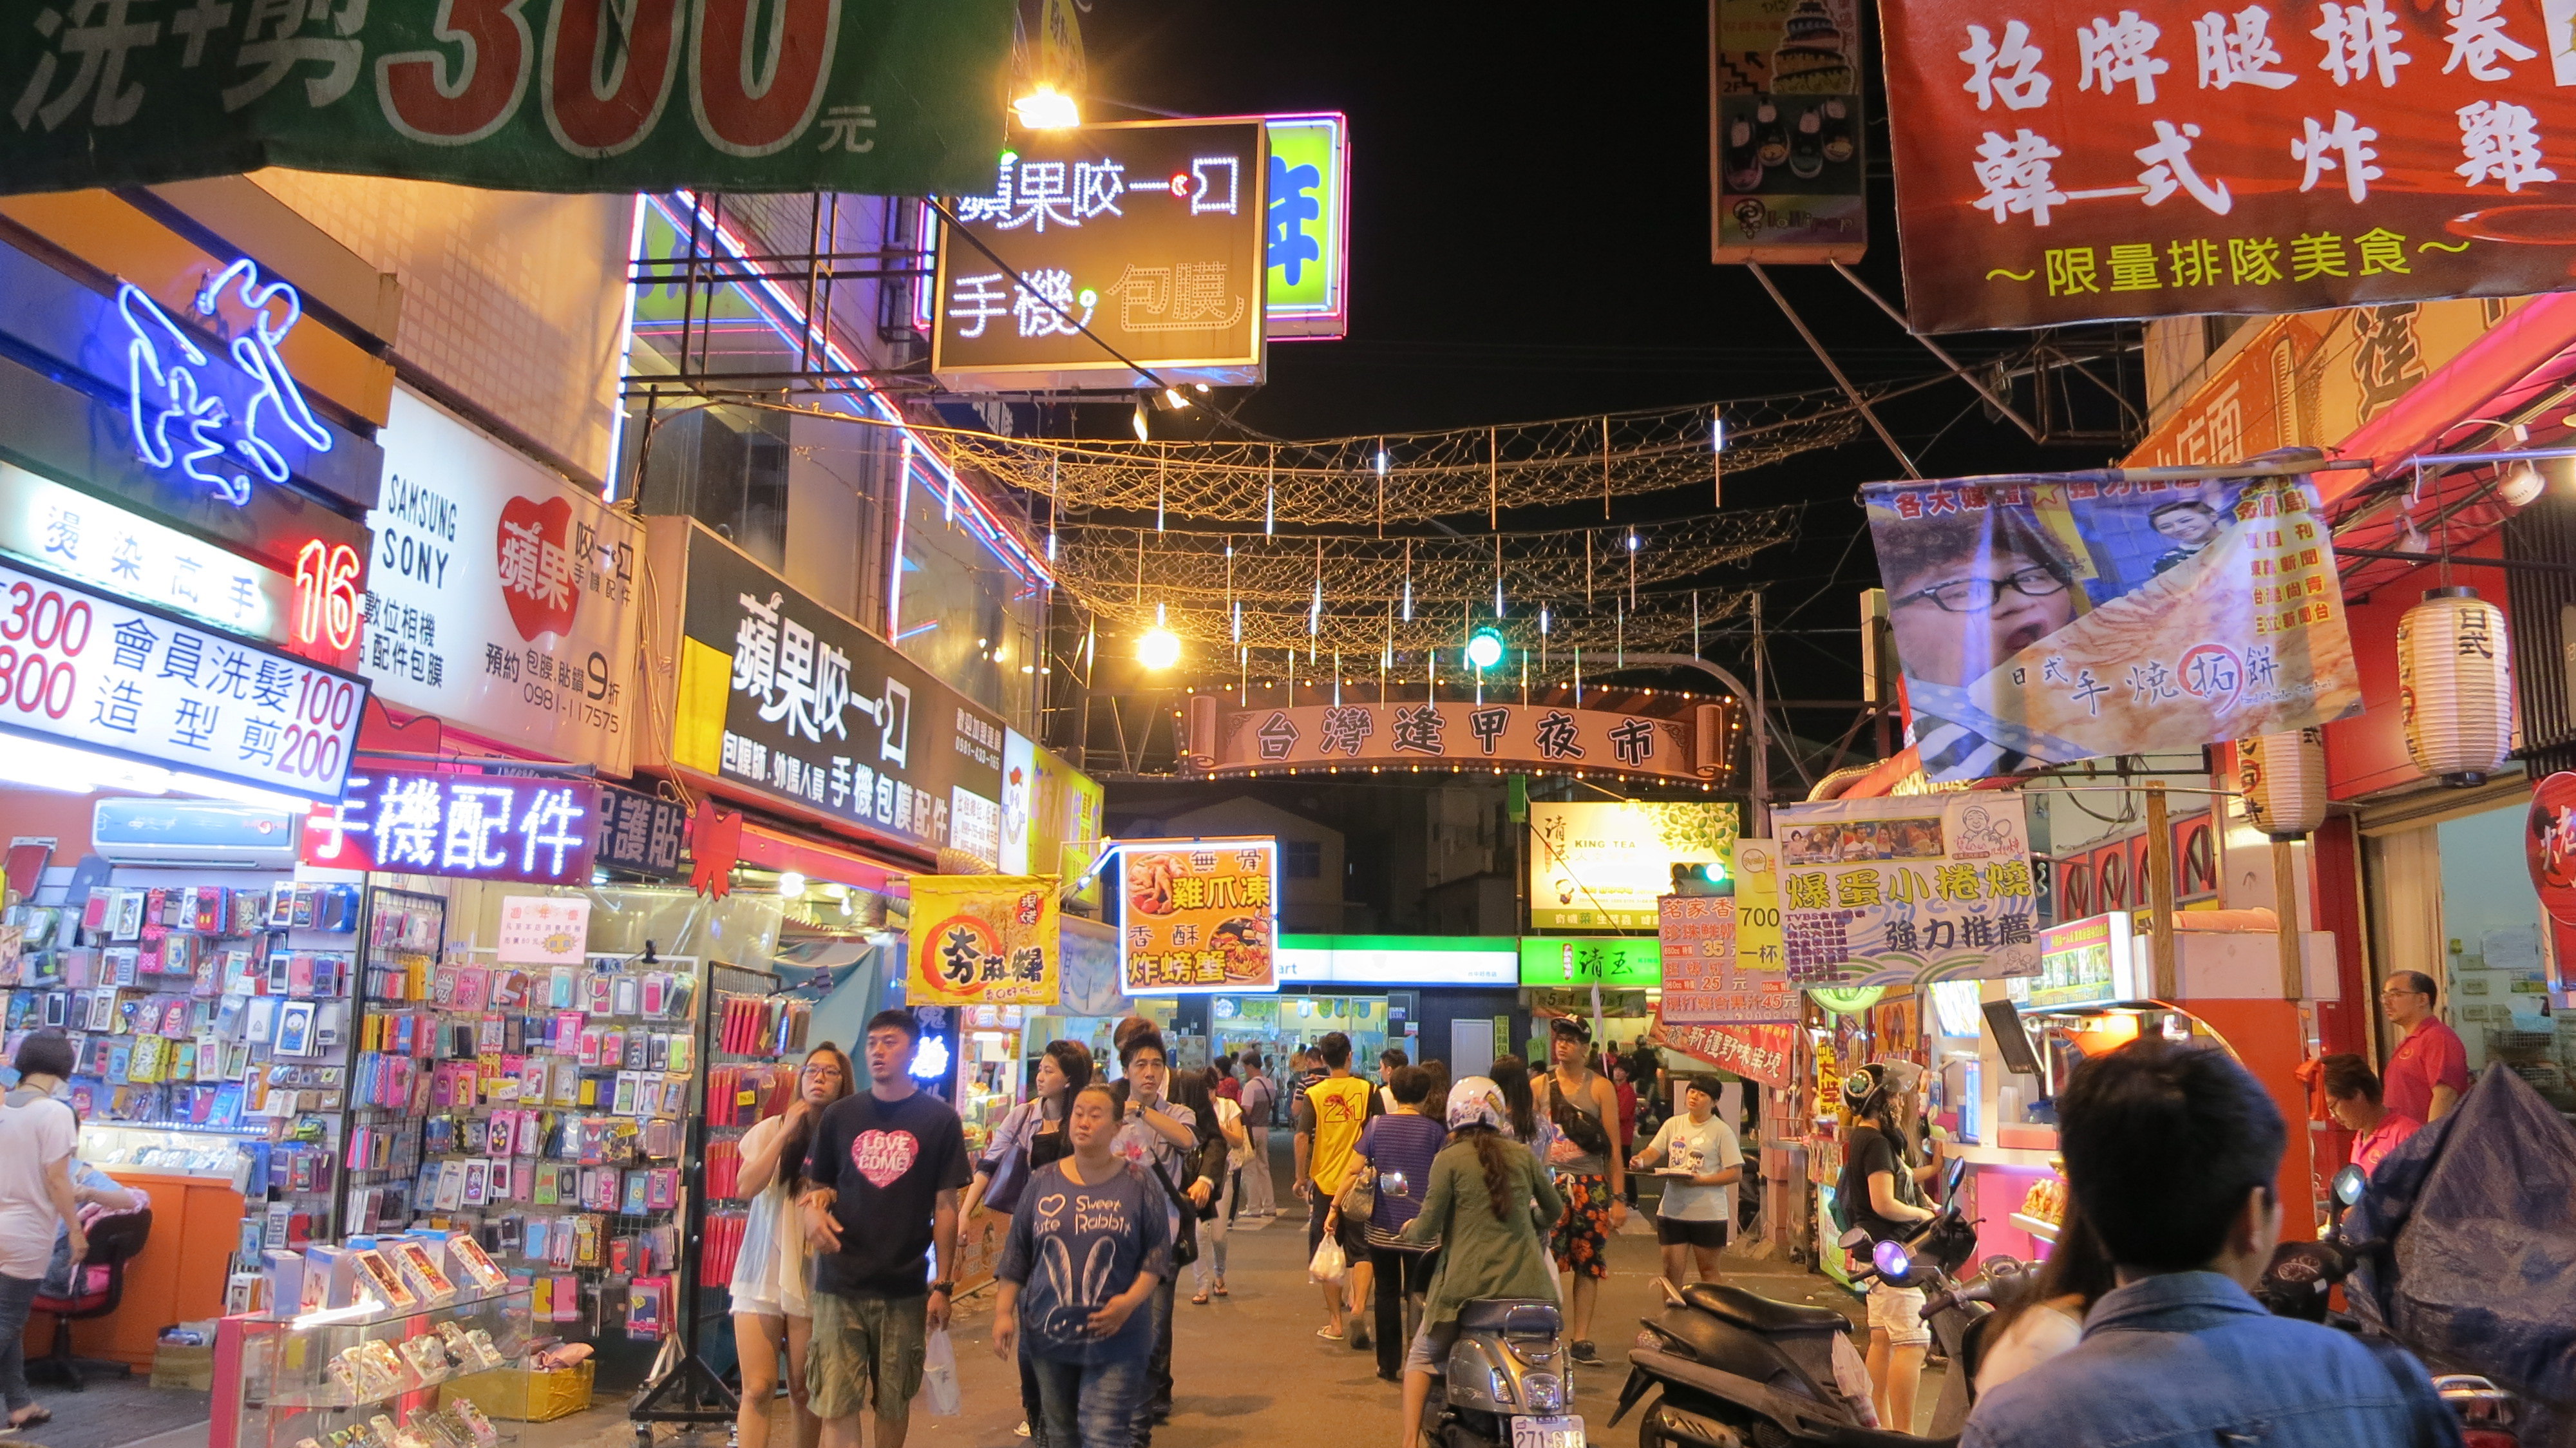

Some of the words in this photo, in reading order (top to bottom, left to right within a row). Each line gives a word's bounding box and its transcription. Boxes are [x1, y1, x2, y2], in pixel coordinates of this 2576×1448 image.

[1958, 0, 2537, 111] 招牌腿排卷
[818, 106, 877, 153] 元
[1972, 100, 2557, 227] 韓式炸雞
[388, 473, 457, 543] SAMSUNG
[45, 504, 255, 618] 燙染高手
[383, 528, 450, 589] SONY
[296, 537, 360, 651] 16
[365, 589, 437, 648] 數位相機
[2458, 607, 2494, 660] 日式
[112, 616, 295, 712] 會員洗髮
[298, 669, 355, 732] 100
[2012, 656, 2069, 686] 日式
[90, 674, 281, 768] 造型剪
[277, 724, 341, 783] 200
[523, 683, 620, 734] 0981-117575
[1256, 703, 1656, 767] 台灣逢甲夜市
[830, 755, 949, 843] 手機包膜配件
[308, 777, 585, 877] 手機配件
[1575, 840, 1605, 849] KING
[1613, 840, 1636, 849] TEA
[1190, 849, 1262, 872] 無骨
[1171, 874, 1273, 910] 雞爪凍
[1739, 908, 1780, 927] 700
[1127, 924, 1200, 947] 香酥
[1702, 940, 1725, 957] 35
[1885, 912, 2033, 953] 強力推薦
[1128, 948, 1227, 985] 炸螃蟹
[1701, 976, 1721, 992] 25
[1732, 978, 1747, 990] 元
[862, 1136, 910, 1152] LOVE
[1075, 1194, 1122, 1212] Sweet
